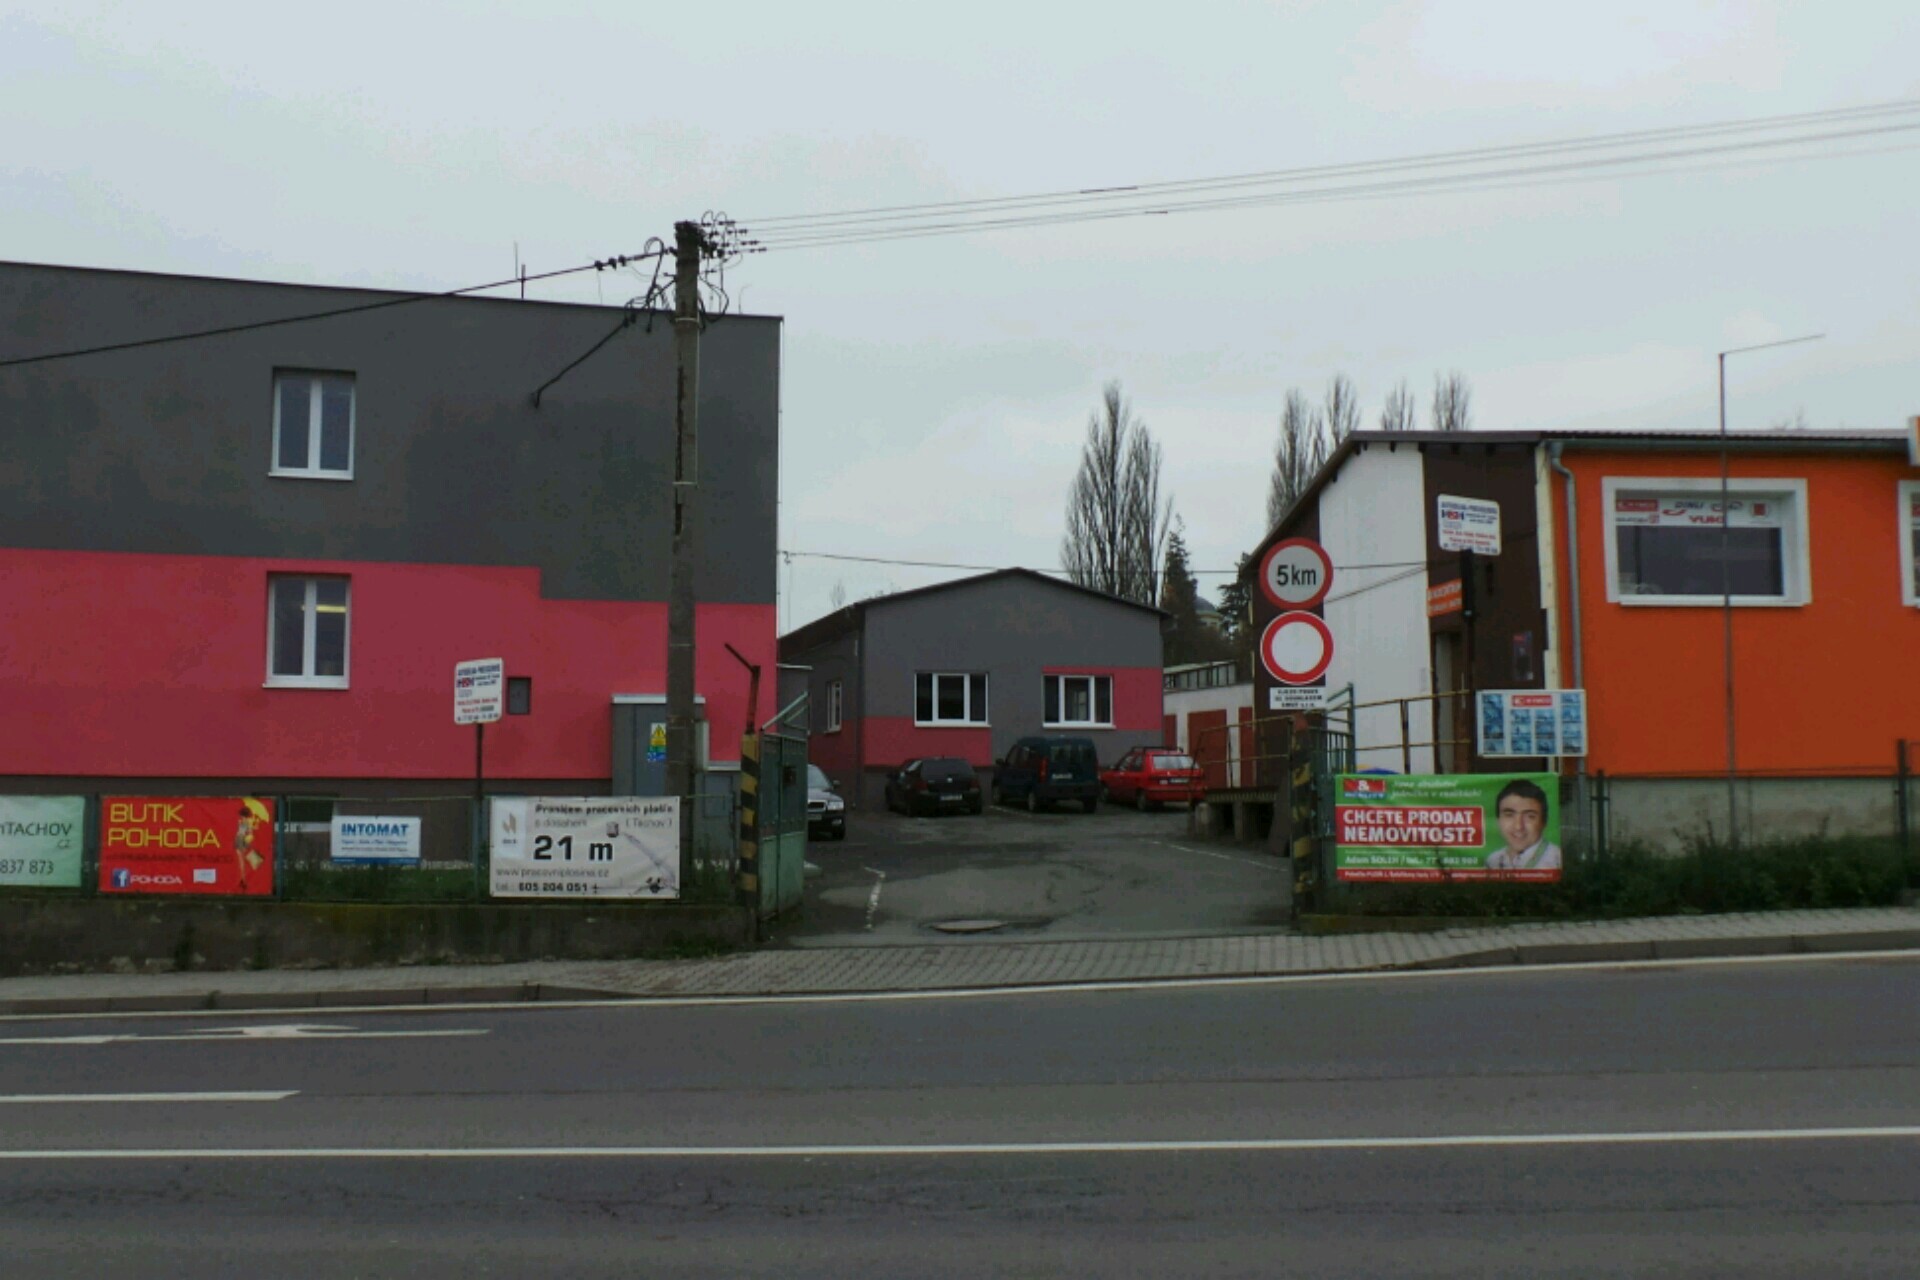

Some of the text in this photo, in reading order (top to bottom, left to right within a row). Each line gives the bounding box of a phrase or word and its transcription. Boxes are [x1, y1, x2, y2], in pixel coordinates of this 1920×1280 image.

[110, 803, 184, 823] BUTIK
[1343, 809, 1474, 824] CHCETE PRODAT
[108, 827, 220, 849] POHODA
[341, 823, 409, 837] INTOMAT
[1344, 826, 1477, 842] NEMOVITOST?
[533, 835, 613, 861] 21 m
[29, 858, 54, 875] 873
[130, 875, 182, 884] POHODA
